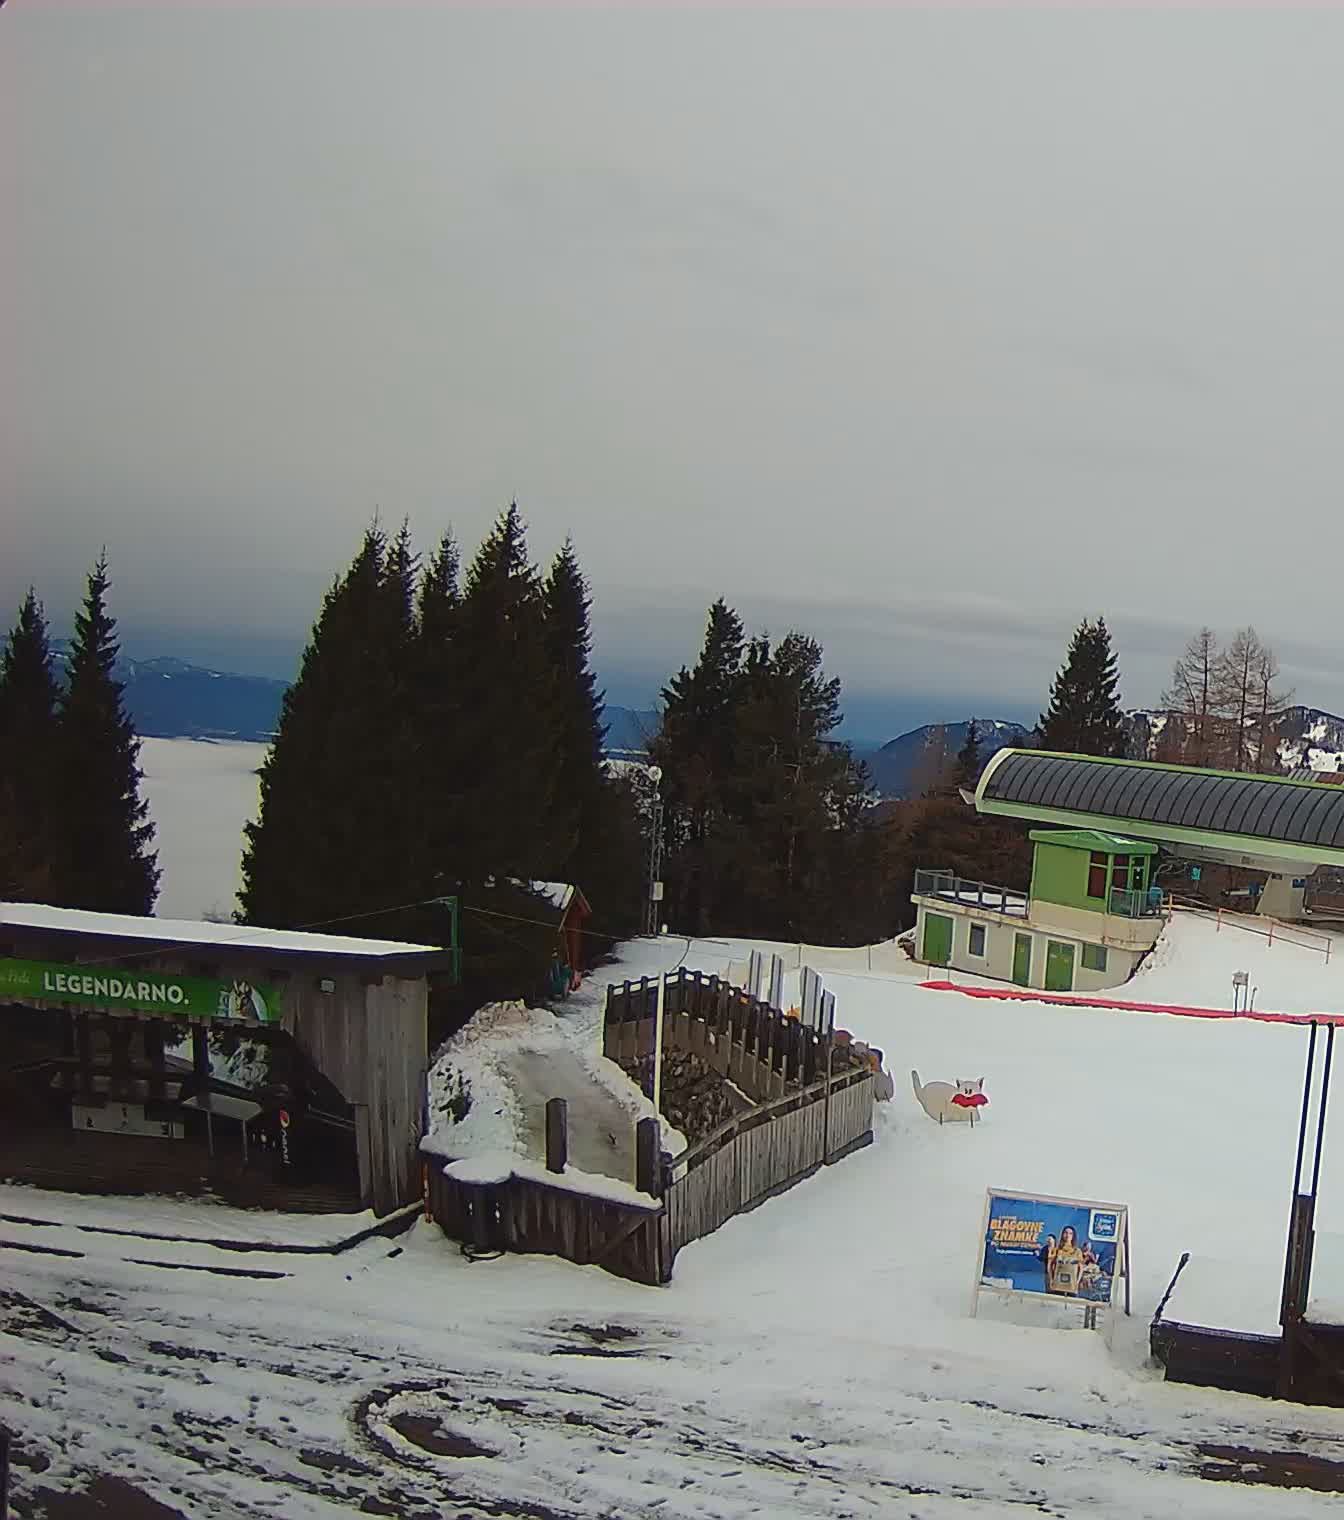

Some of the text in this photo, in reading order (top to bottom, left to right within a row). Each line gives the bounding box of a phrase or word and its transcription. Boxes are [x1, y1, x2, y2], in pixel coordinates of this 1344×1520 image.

[44, 971, 190, 1005] LEGENDARNO.
[990, 1219, 1045, 1233] BLAGOVNE
[993, 1229, 1039, 1243] ZNAMKE
